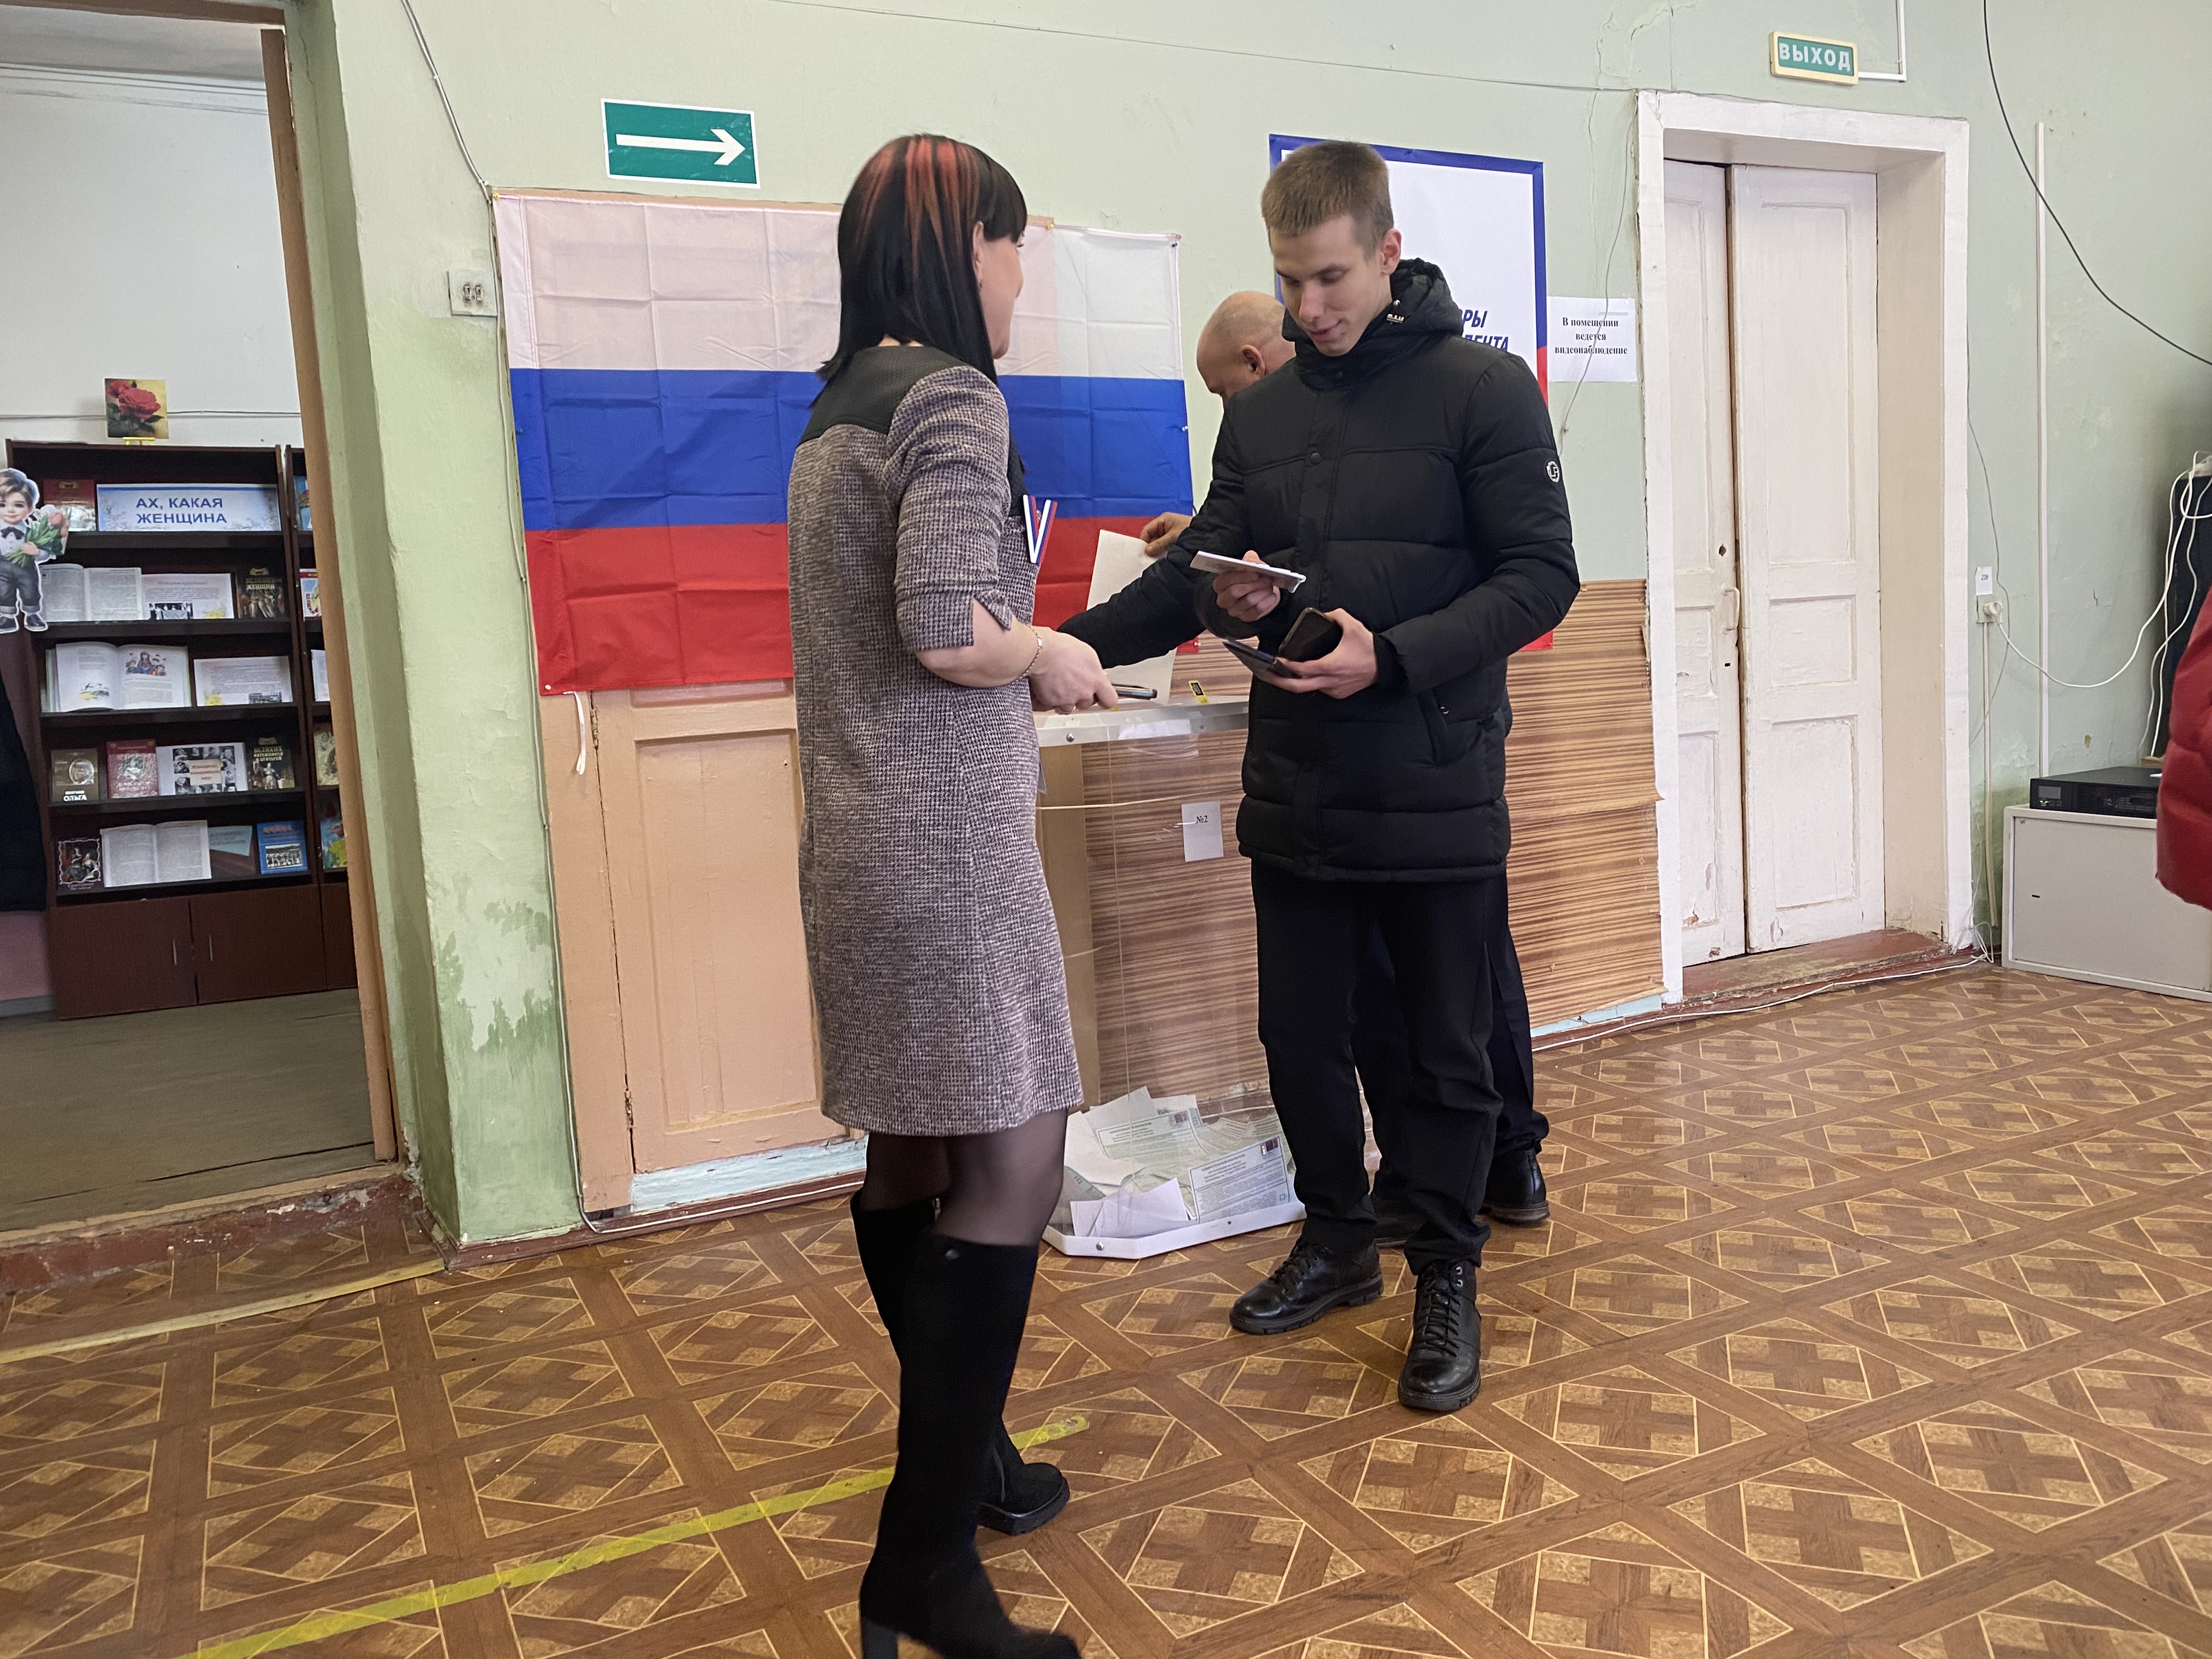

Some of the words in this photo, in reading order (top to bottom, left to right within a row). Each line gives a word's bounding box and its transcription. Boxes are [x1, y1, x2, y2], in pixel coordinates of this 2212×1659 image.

[1779, 42, 1850, 72] ВЫХОД
[1563, 317, 1568, 326] В
[1555, 345, 1628, 355] видеонаблюдение
[136, 498, 163, 510] АХ,
[168, 498, 223, 508] КАКАЯ
[136, 513, 227, 525] ЖЕНЩИНА
[1196, 815, 1208, 824] №2
